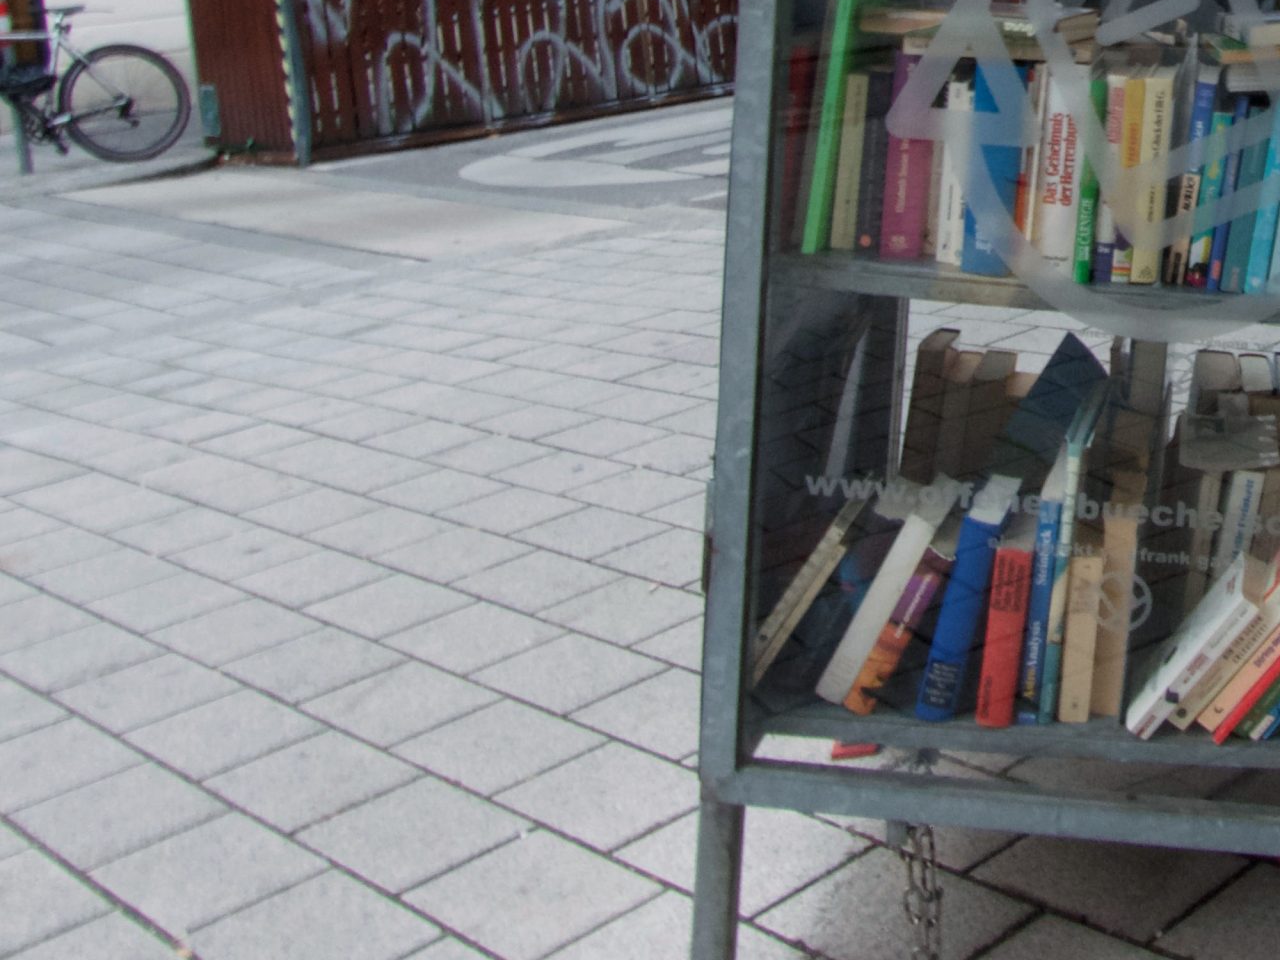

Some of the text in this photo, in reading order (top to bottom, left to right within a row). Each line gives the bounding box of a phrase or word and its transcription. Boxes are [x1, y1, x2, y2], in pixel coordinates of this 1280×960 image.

[1043, 112, 1064, 205] Das Geheimnis
[1059, 186, 1072, 206] der
[1138, 548, 1191, 567] frank
